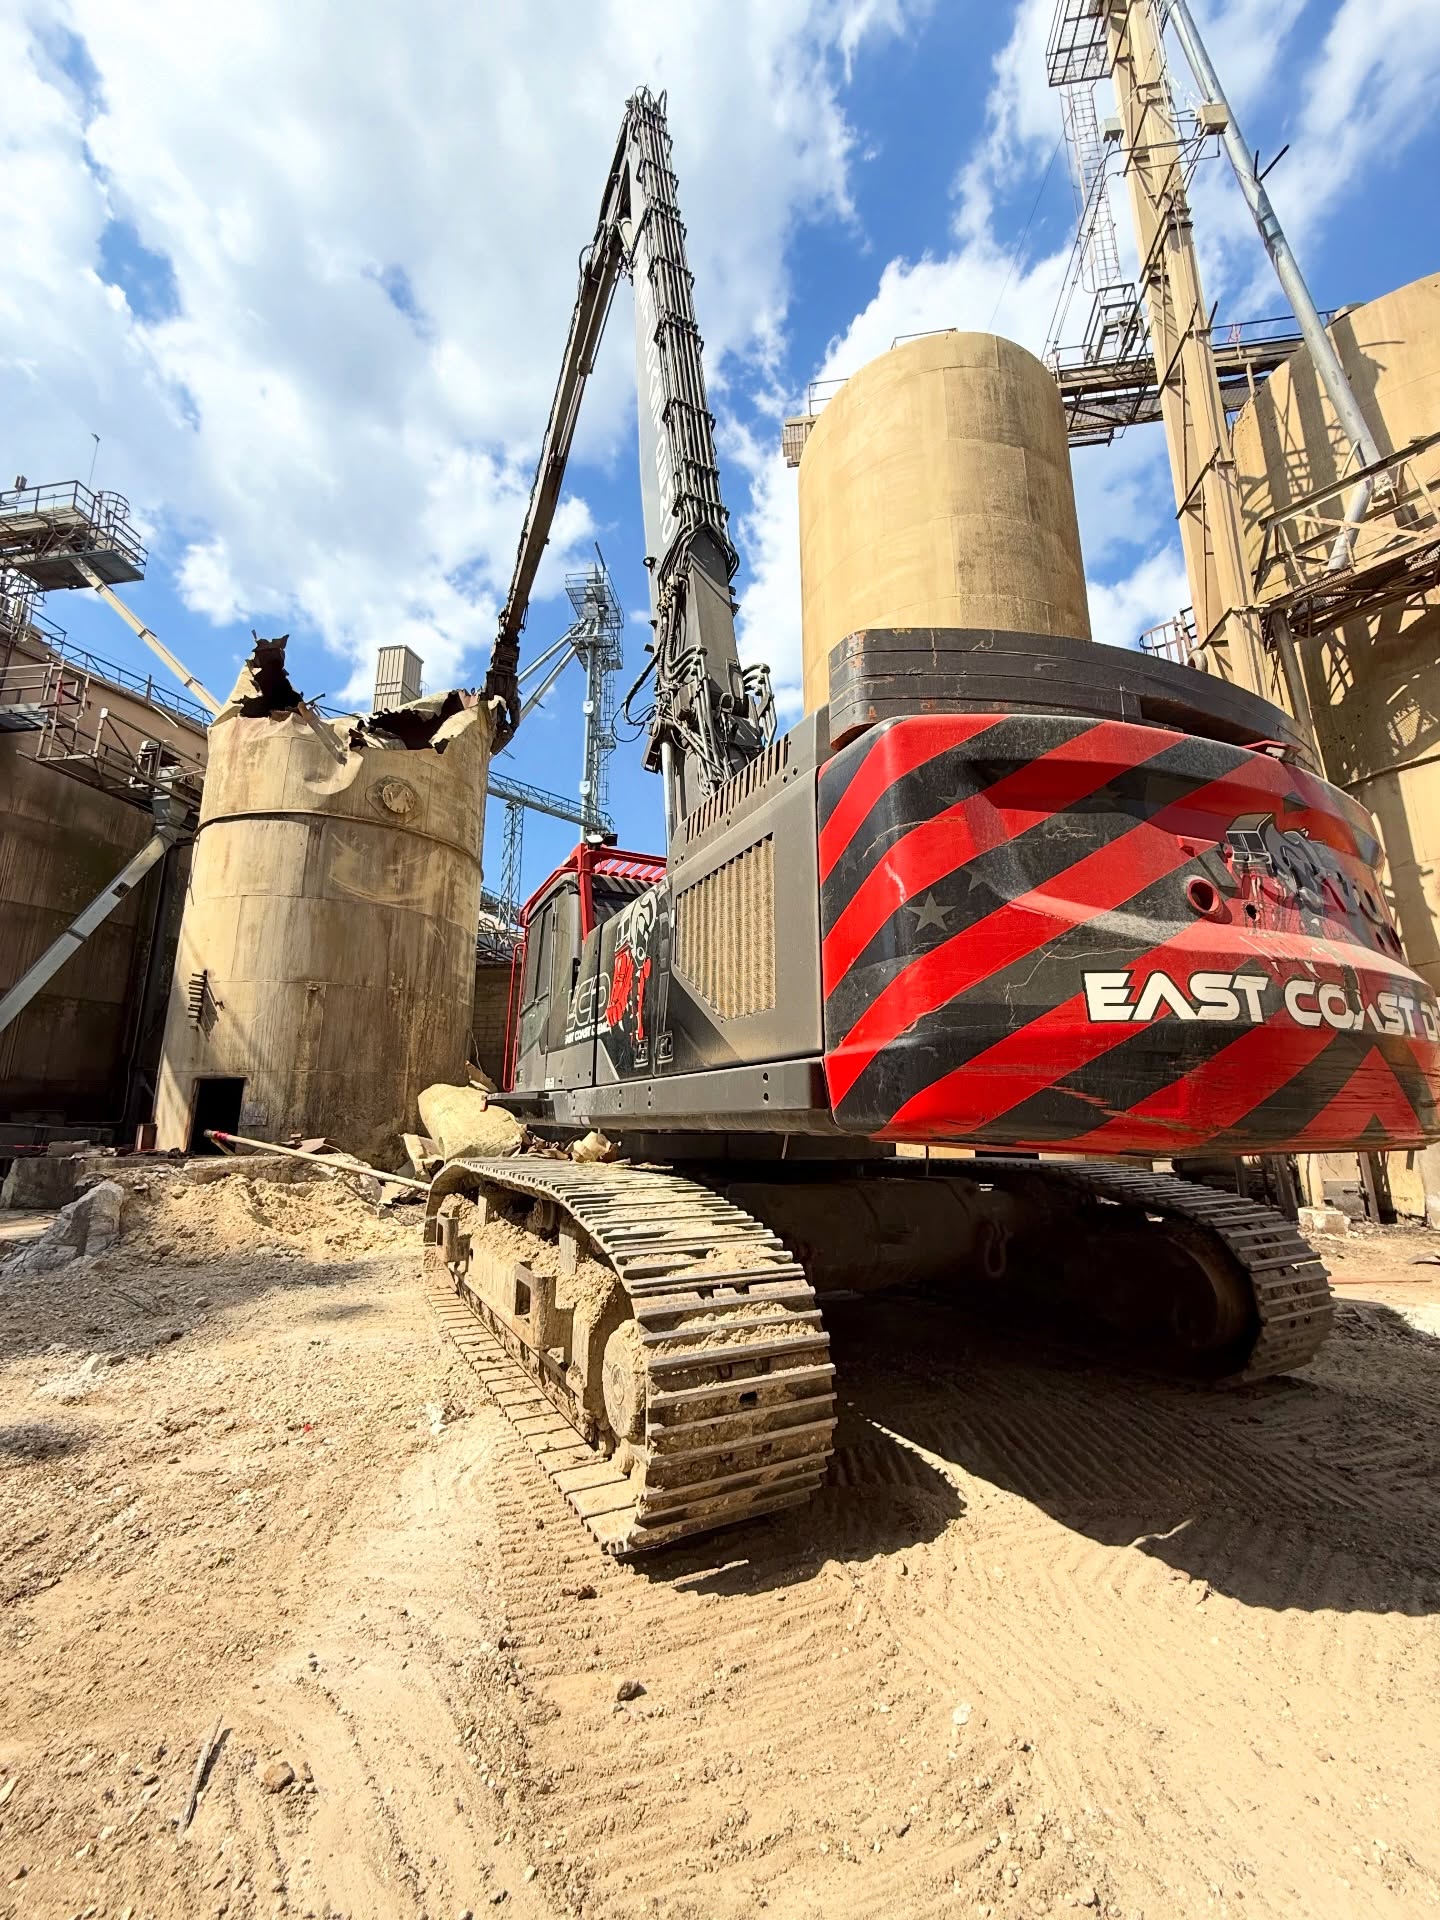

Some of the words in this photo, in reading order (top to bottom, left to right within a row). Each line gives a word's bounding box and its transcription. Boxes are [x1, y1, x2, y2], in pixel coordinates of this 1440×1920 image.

[656, 433, 676, 544] DEMO
[1083, 971, 1269, 1022] EAST
[1284, 979, 1416, 1038] COAST
